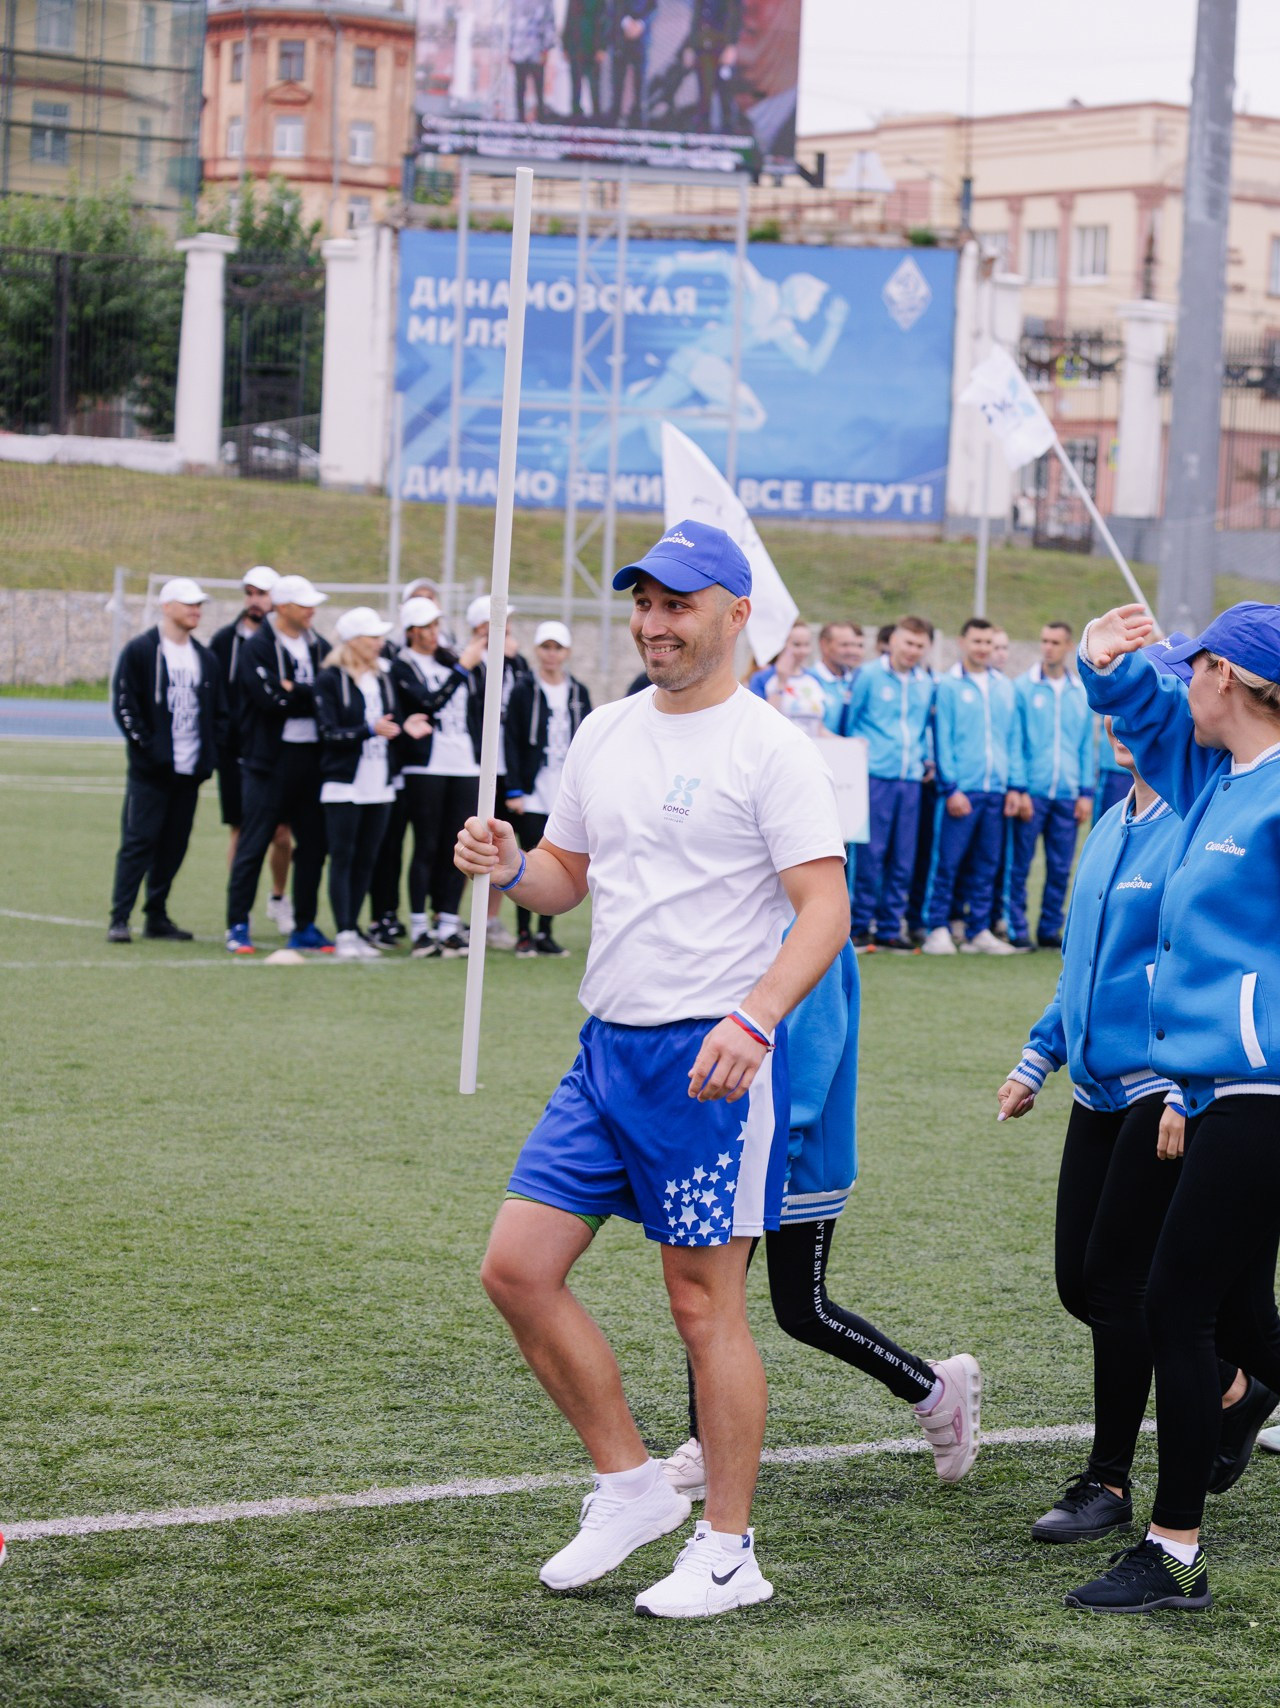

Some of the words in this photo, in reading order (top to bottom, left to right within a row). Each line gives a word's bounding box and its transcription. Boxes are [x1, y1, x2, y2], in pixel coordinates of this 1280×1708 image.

[409, 275, 698, 316] ДИНАМОВСКАЯ
[406, 314, 509, 349] МИЛЯ
[569, 471, 666, 506] БЕЖИ
[738, 478, 804, 511] ВСЕ
[811, 480, 934, 515] БЕГУТ!
[662, 804, 690, 816] КОМОС
[844, 1328, 876, 1350] DON'T
[873, 1344, 887, 1358] BE
[884, 1351, 902, 1367] SHY
